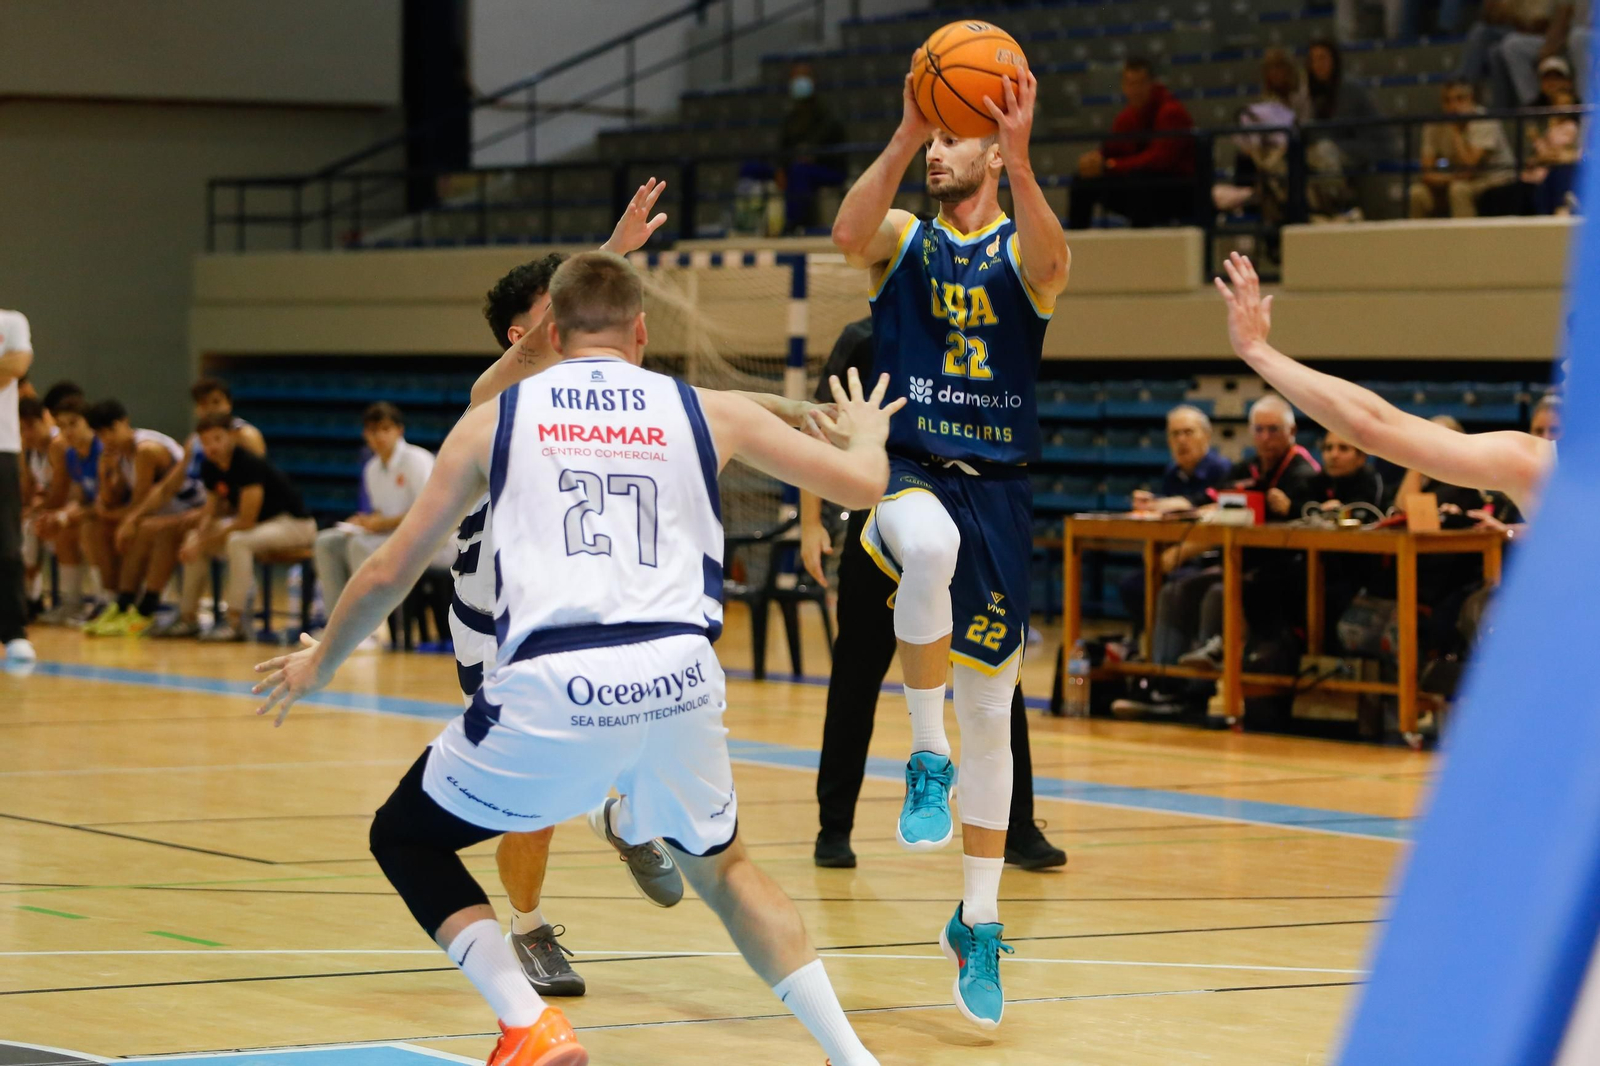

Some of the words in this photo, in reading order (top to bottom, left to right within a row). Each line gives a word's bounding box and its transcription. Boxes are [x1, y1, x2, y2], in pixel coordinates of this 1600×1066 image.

[954, 255, 970, 266] ive
[942, 330, 993, 381] 22
[551, 387, 646, 411] KRASTS
[938, 385, 1022, 408] damex.io
[538, 423, 667, 447] MIRAMAR
[918, 416, 1012, 443] ALGECIRAS
[541, 447, 592, 457] CENTRO
[594, 448, 668, 462] COMERCIAL
[559, 468, 658, 568] 27
[987, 603, 1006, 616] vive
[965, 614, 1008, 651] 22
[571, 715, 595, 727] SEA
[598, 713, 641, 727] BEAUTY
[643, 694, 710, 722] TTECHNOLOG
